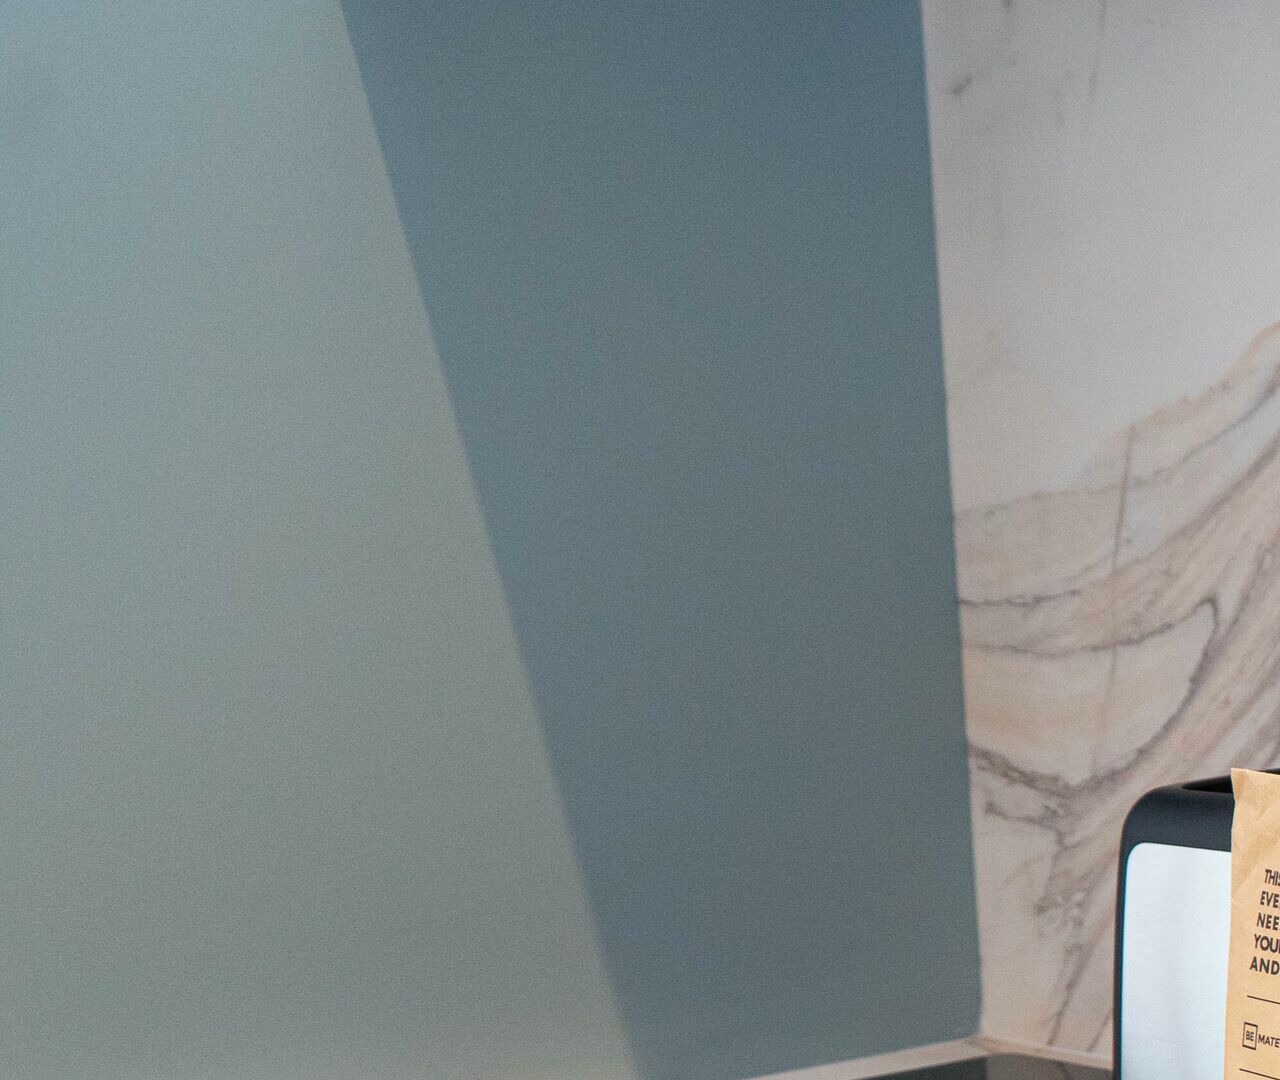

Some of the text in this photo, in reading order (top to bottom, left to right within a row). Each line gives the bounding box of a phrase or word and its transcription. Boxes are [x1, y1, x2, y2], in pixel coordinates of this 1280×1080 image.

[1250, 957, 1280, 975] AND
[1245, 1030, 1255, 1042] BE
[1258, 1034, 1280, 1048] MATE
